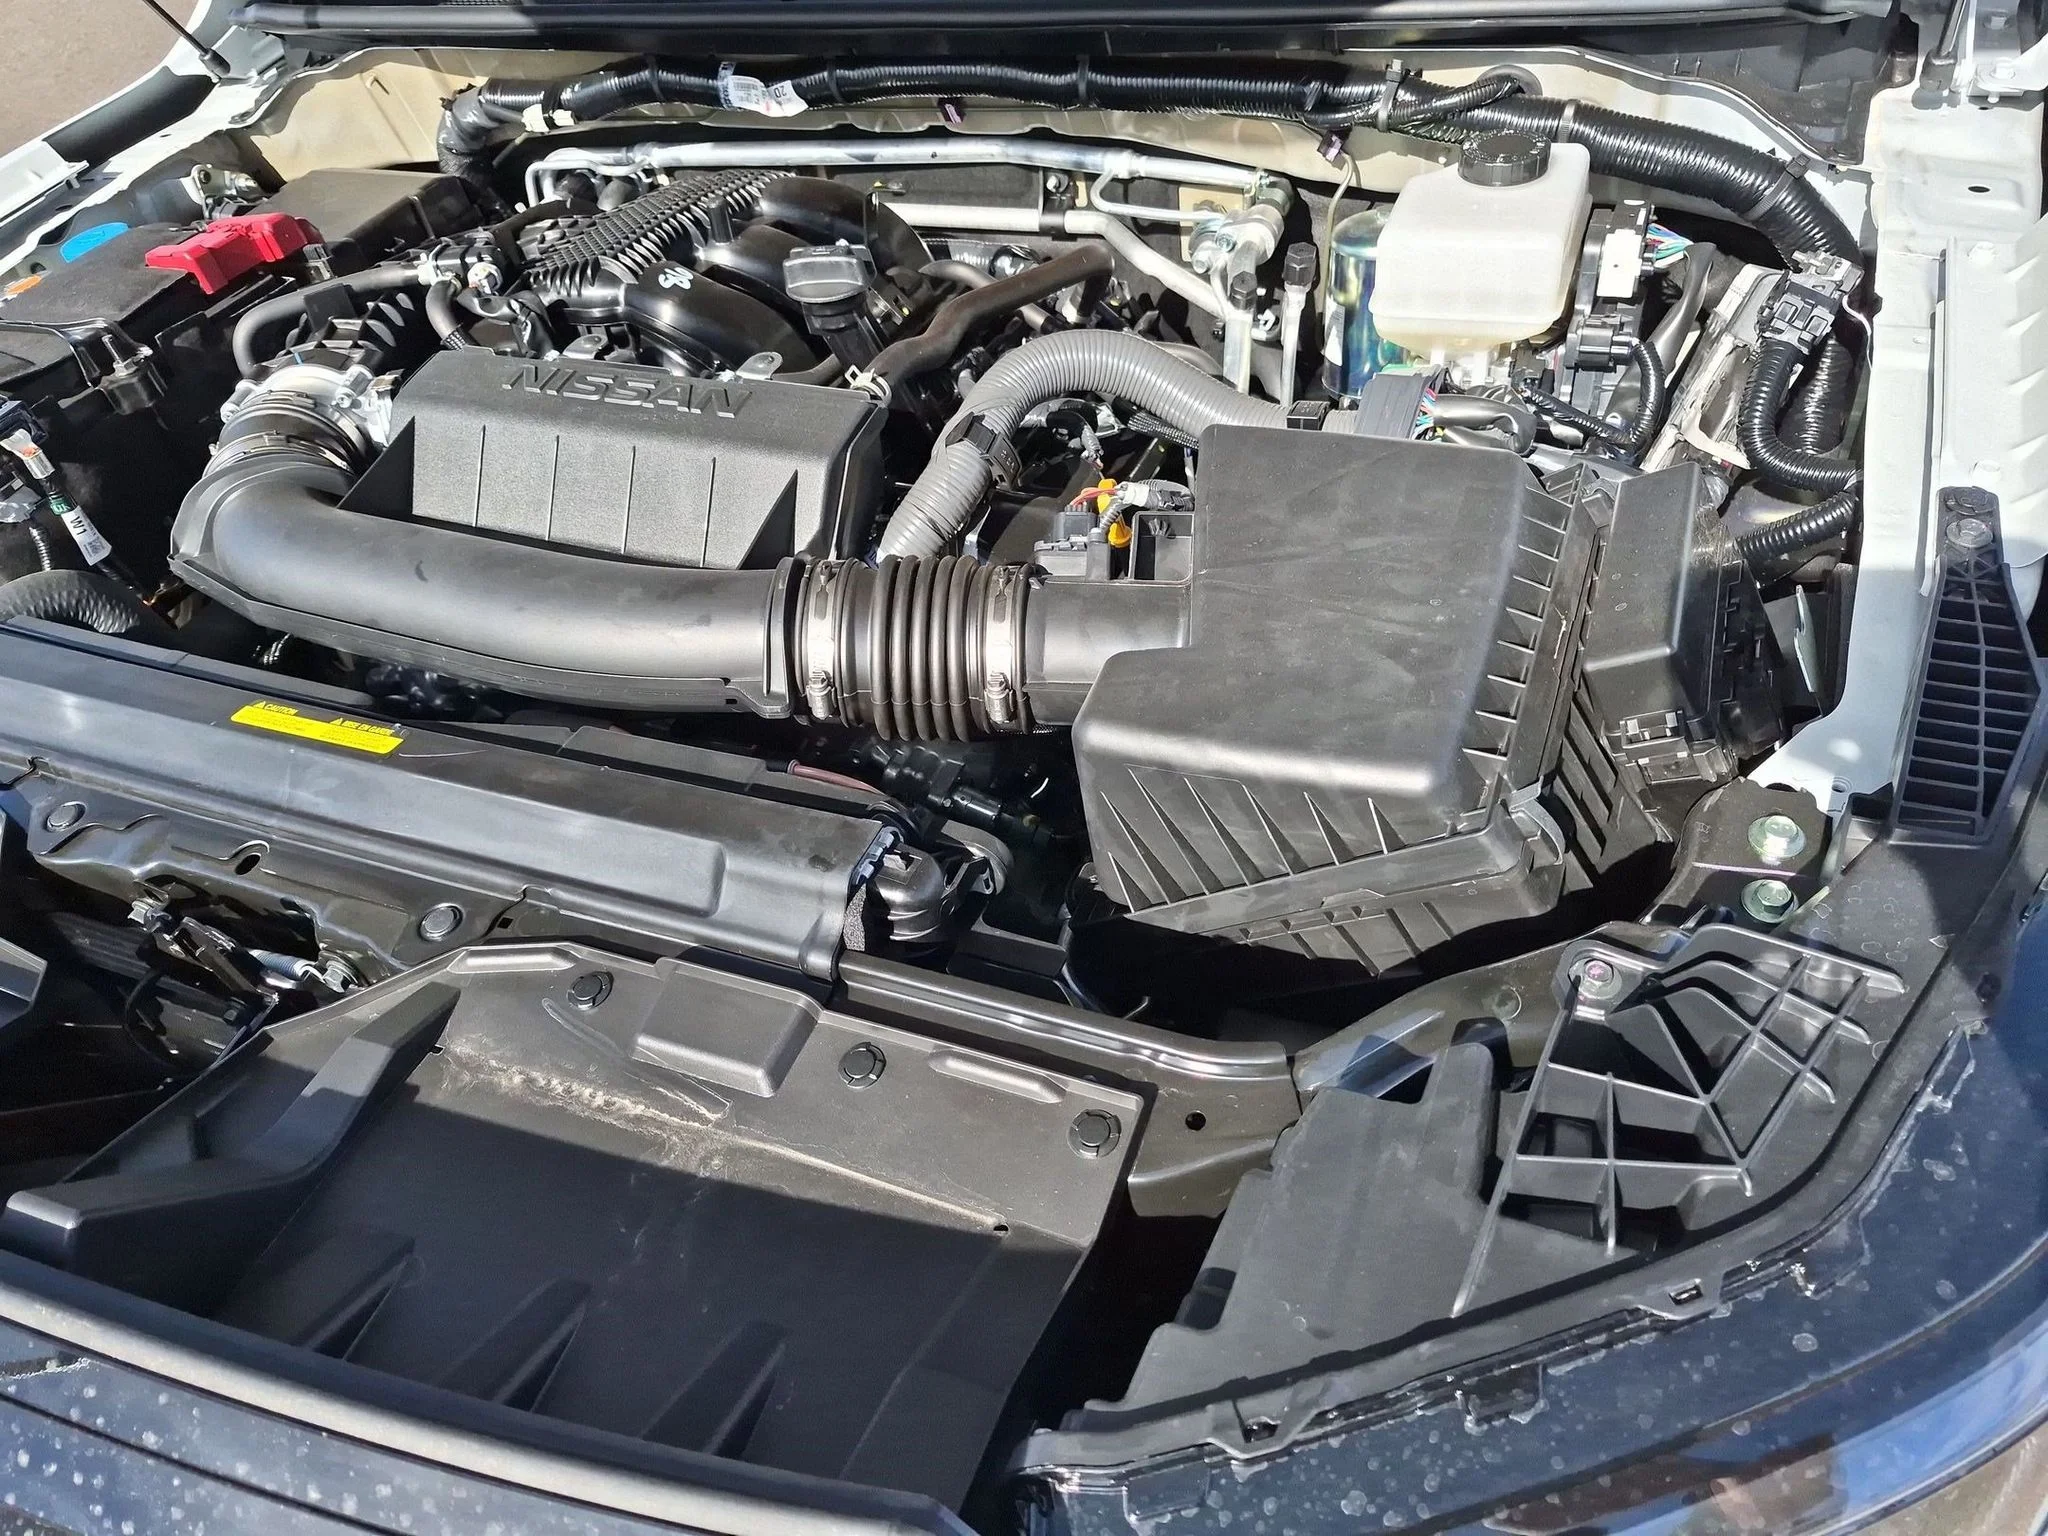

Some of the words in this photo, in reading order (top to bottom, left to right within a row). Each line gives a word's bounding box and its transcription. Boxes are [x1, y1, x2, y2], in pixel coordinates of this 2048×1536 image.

[502, 365, 753, 419] NISSAN
[70, 515, 87, 536] W1
[264, 703, 299, 716] CAUTION
